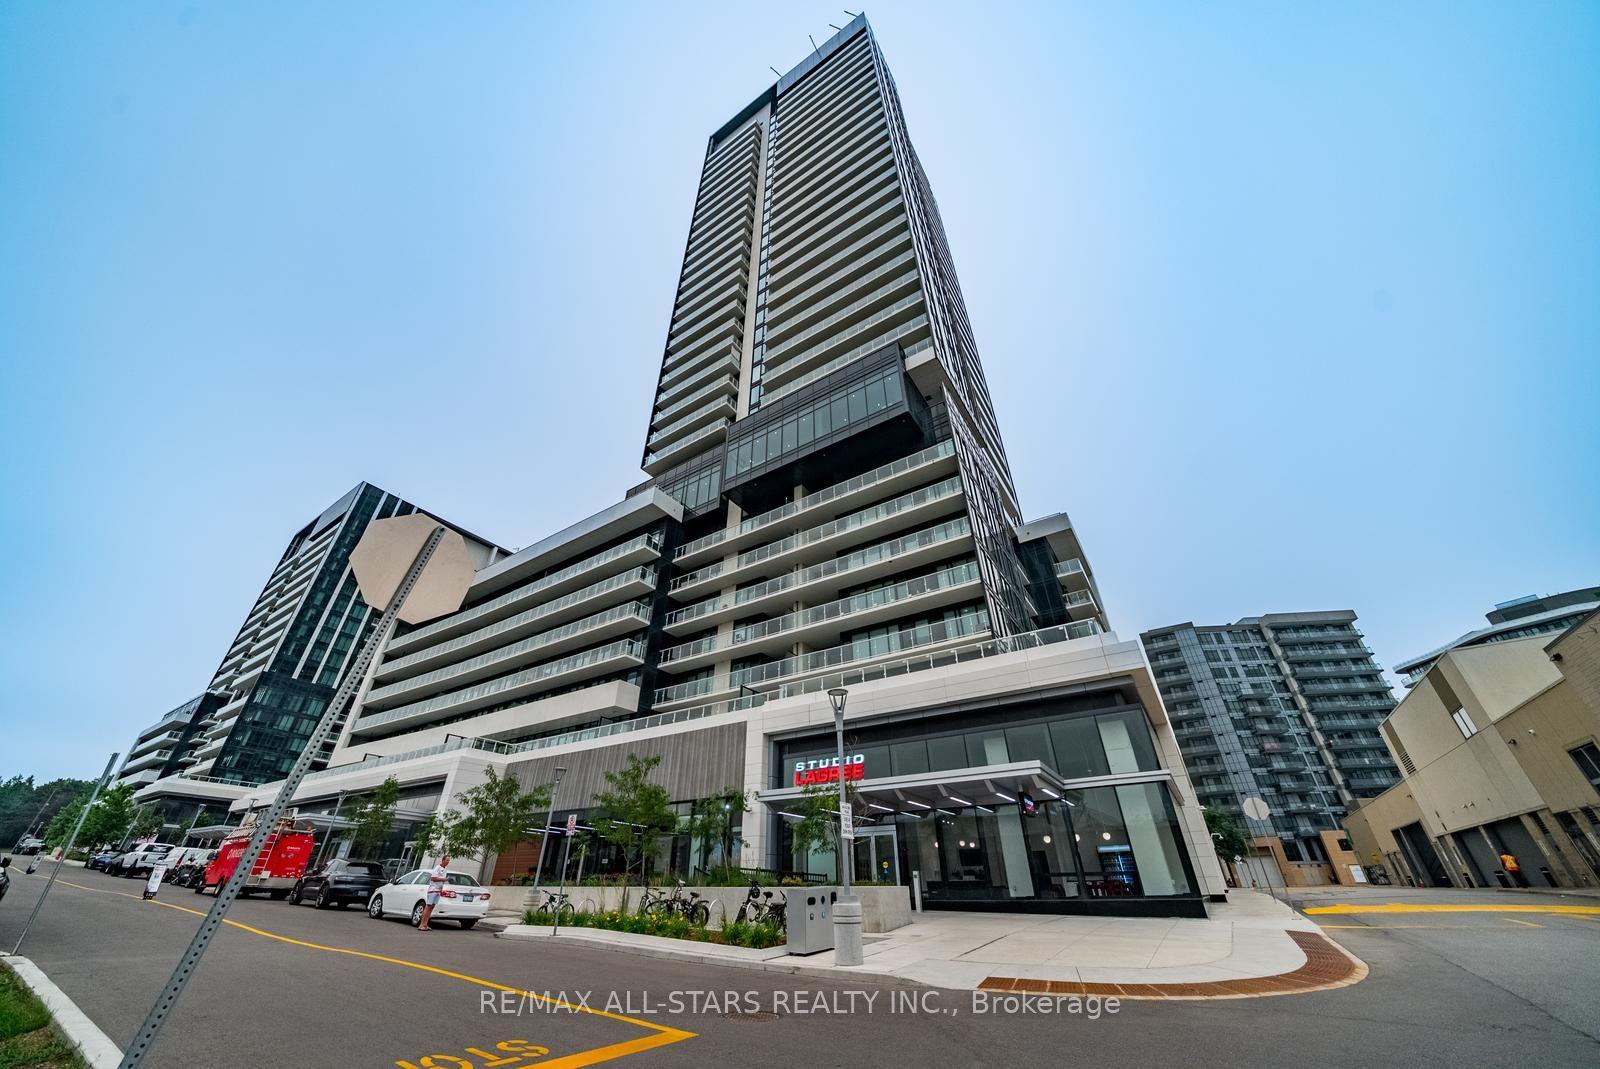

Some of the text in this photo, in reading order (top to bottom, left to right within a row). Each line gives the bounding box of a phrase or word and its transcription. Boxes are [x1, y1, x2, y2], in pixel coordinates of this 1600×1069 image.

[795, 753, 865, 772] STUDIO
[795, 763, 865, 786] LAGREE
[395, 1039, 549, 1069] STO
